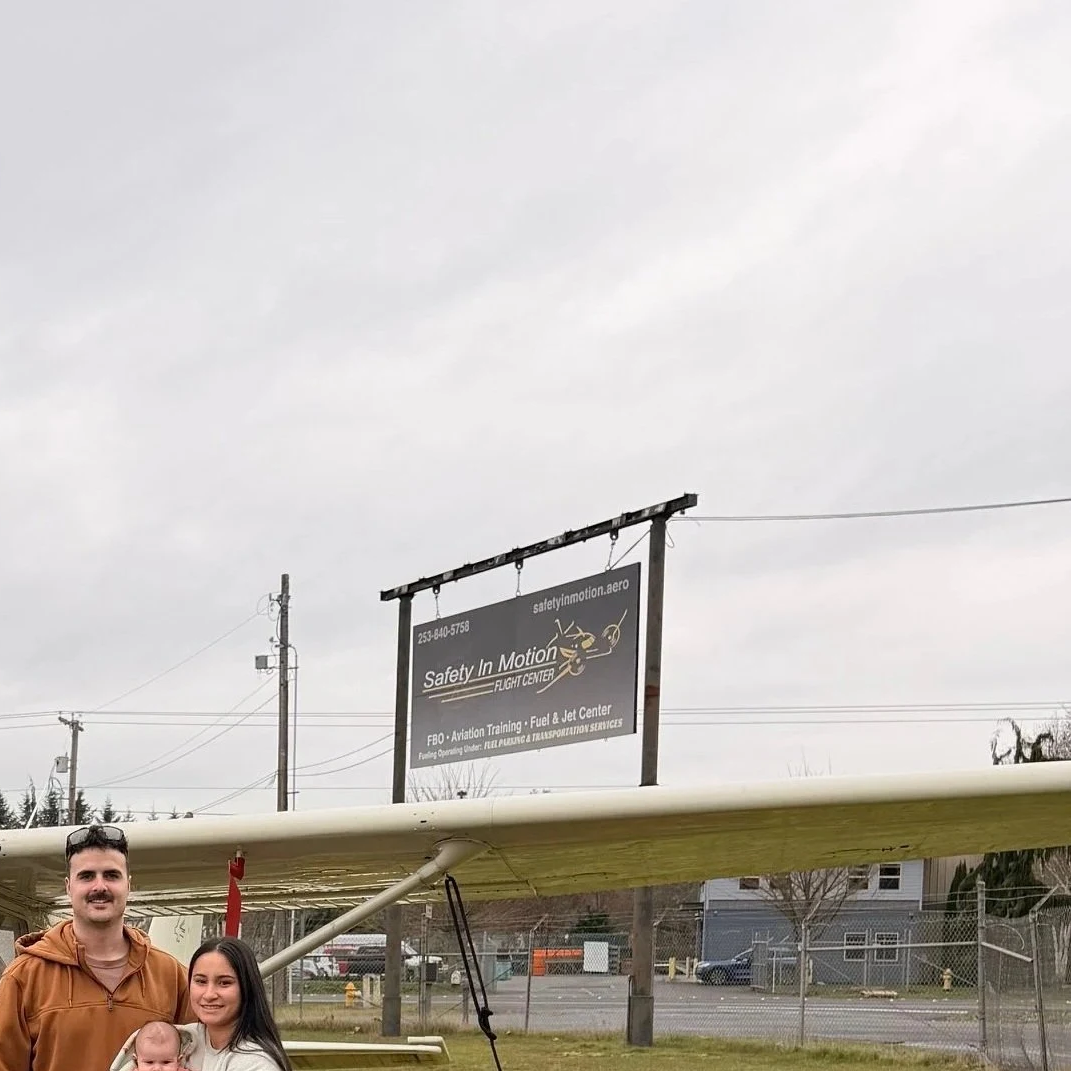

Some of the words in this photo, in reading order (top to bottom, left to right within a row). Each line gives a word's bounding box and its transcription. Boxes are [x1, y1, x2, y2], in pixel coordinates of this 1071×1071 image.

[533, 579, 629, 614] safetyinmotion.aero
[418, 620, 470, 645] 253-840-5758
[423, 664, 474, 688] Safety
[478, 659, 493, 677] In
[498, 646, 557, 672] Motion
[494, 676, 523, 692] FLIGHT
[522, 668, 555, 686] CENTER
[427, 732, 444, 746] FBO
[451, 727, 485, 742] Aviation
[487, 720, 522, 734] Training
[530, 713, 550, 729] Fuel
[552, 712, 559, 724] &
[562, 709, 577, 722] Jet
[579, 704, 612, 720] Center
[532, 724, 589, 742] TRANSPORTATION
[589, 718, 623, 733] SERVICES
